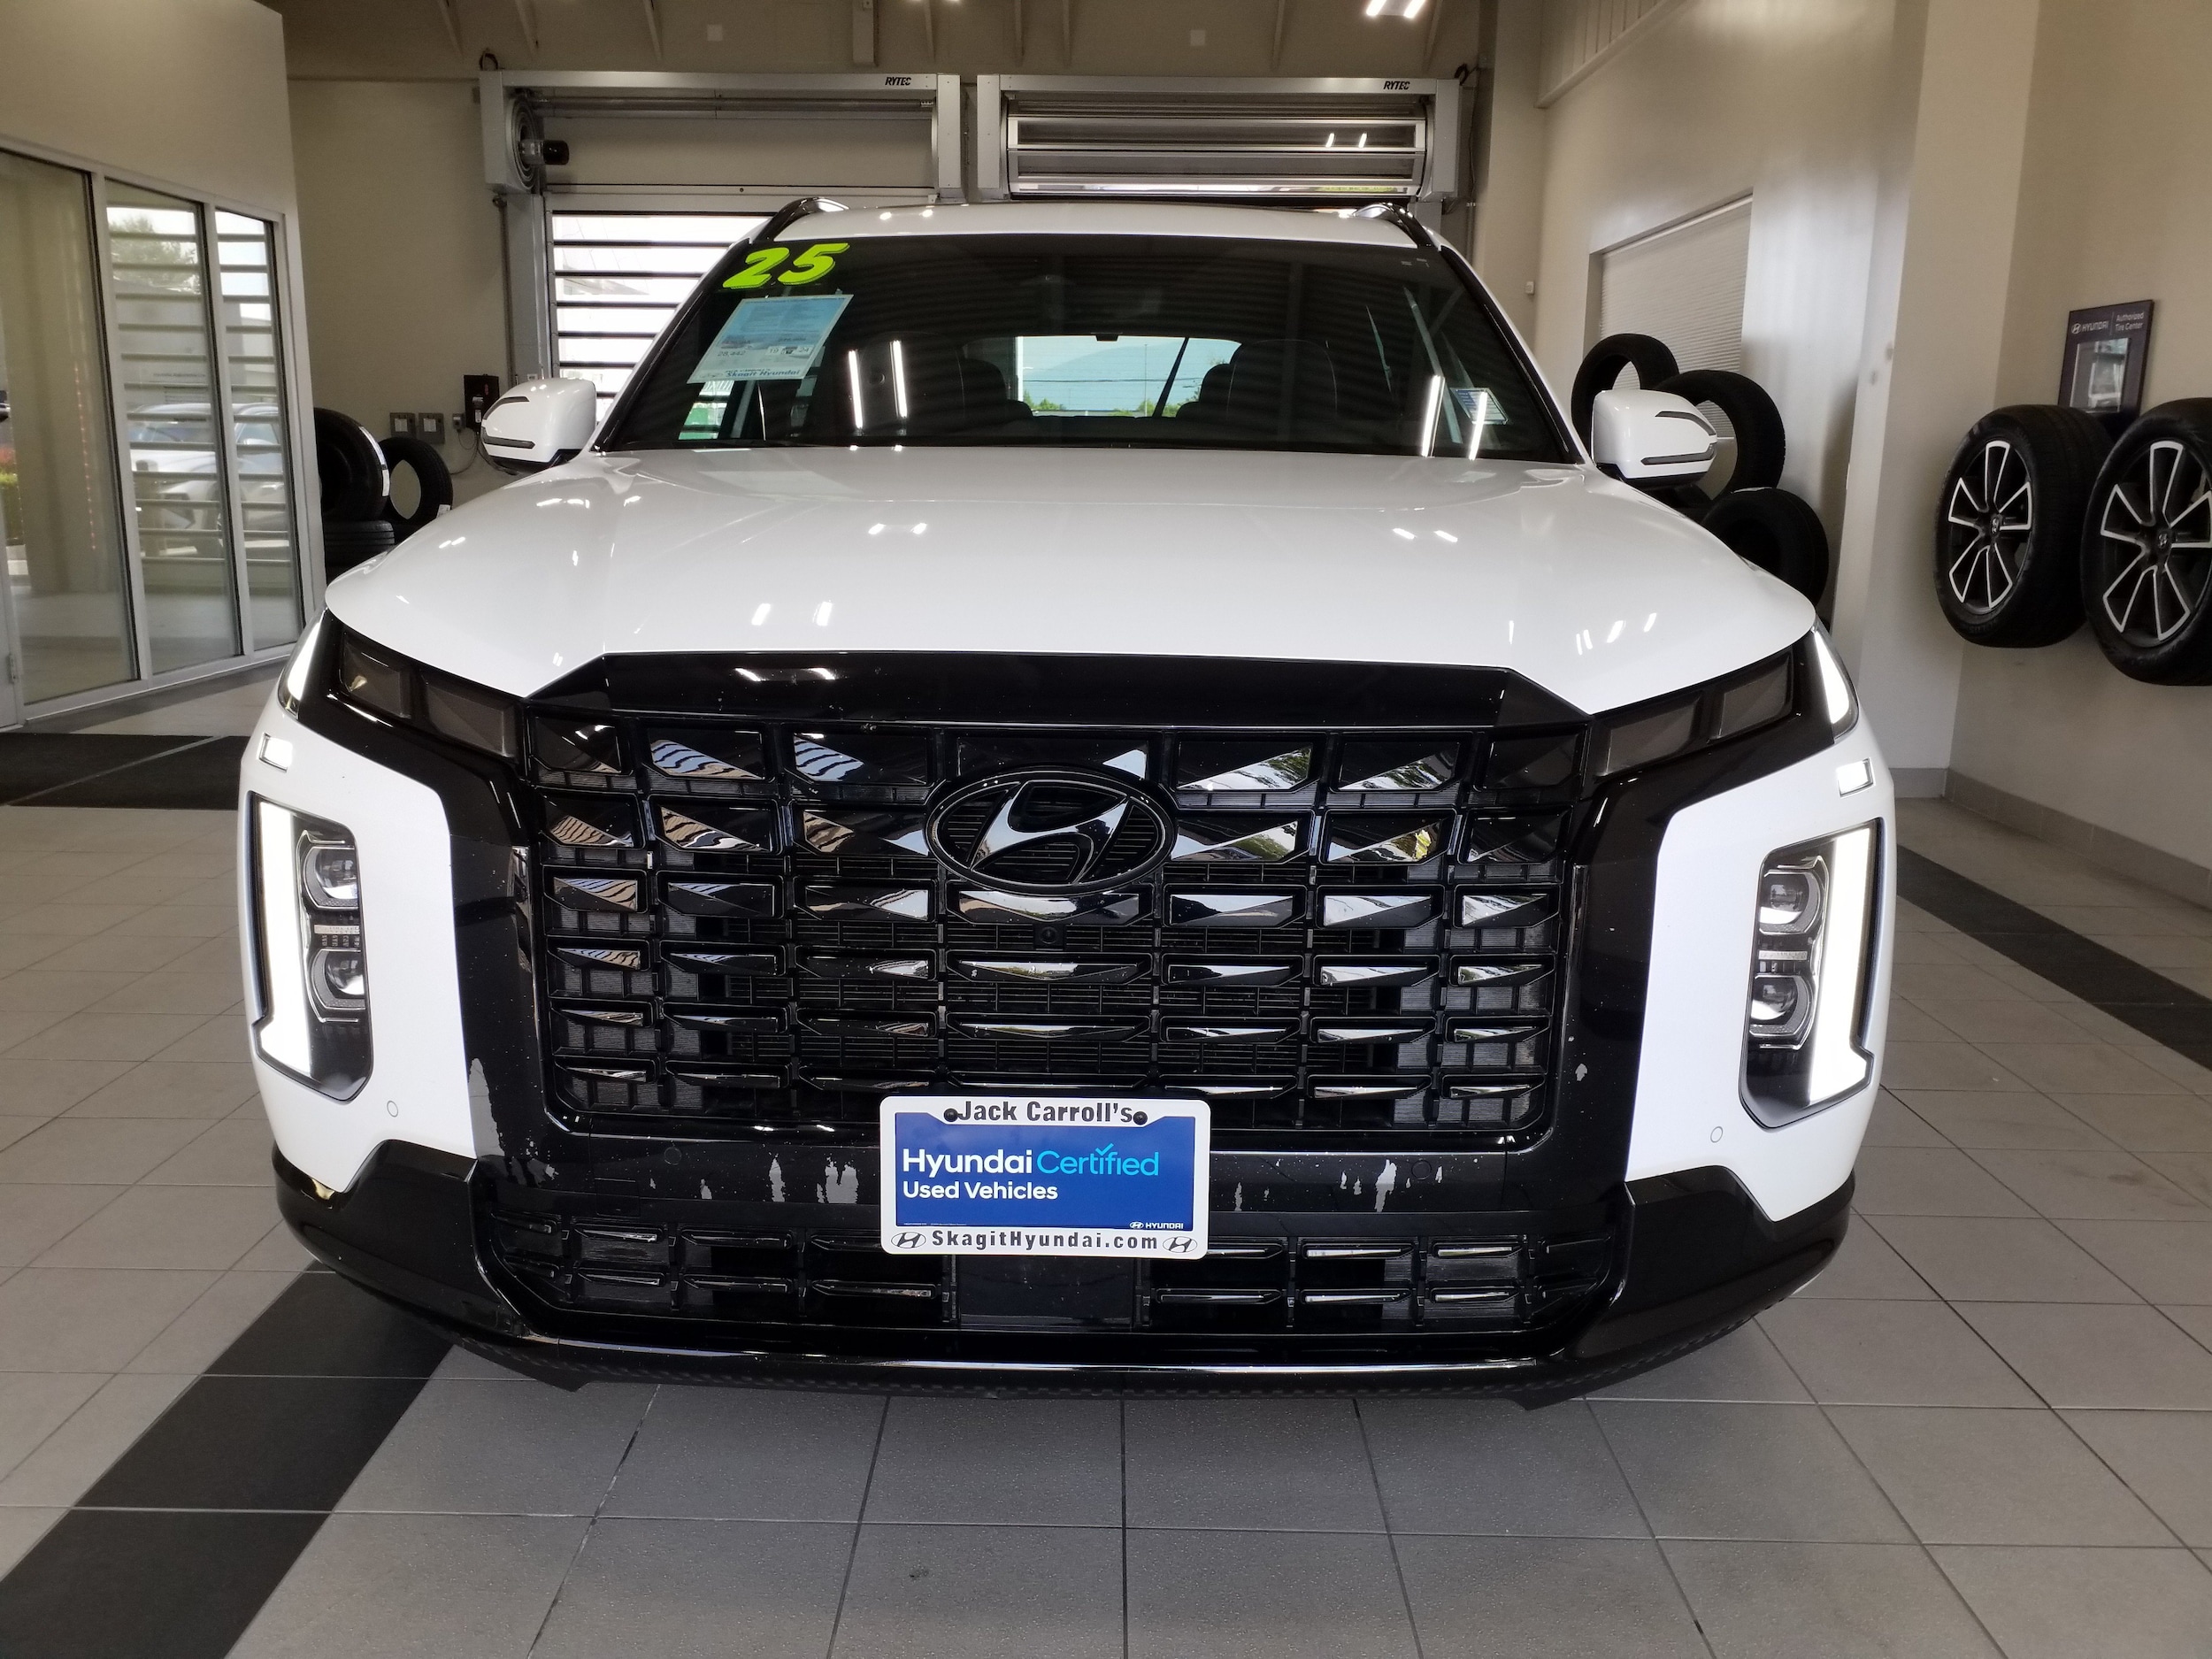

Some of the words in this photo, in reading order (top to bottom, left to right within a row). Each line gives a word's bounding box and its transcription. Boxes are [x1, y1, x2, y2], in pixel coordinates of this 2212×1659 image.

[885, 76, 911, 86] RYTEC
[1383, 81, 1410, 90] RYTEC
[722, 242, 850, 289] 25
[2082, 320, 2108, 332] HYUNDAI
[958, 1101, 1018, 1122] Jack
[1026, 1102, 1133, 1123] Carroll's
[902, 1148, 1033, 1179] Hyundai
[1037, 1145, 1159, 1176] Certified
[902, 1180, 960, 1199] Used
[964, 1181, 1058, 1200] Vehicles
[932, 1230, 1158, 1251] SkagitHyundai.com
